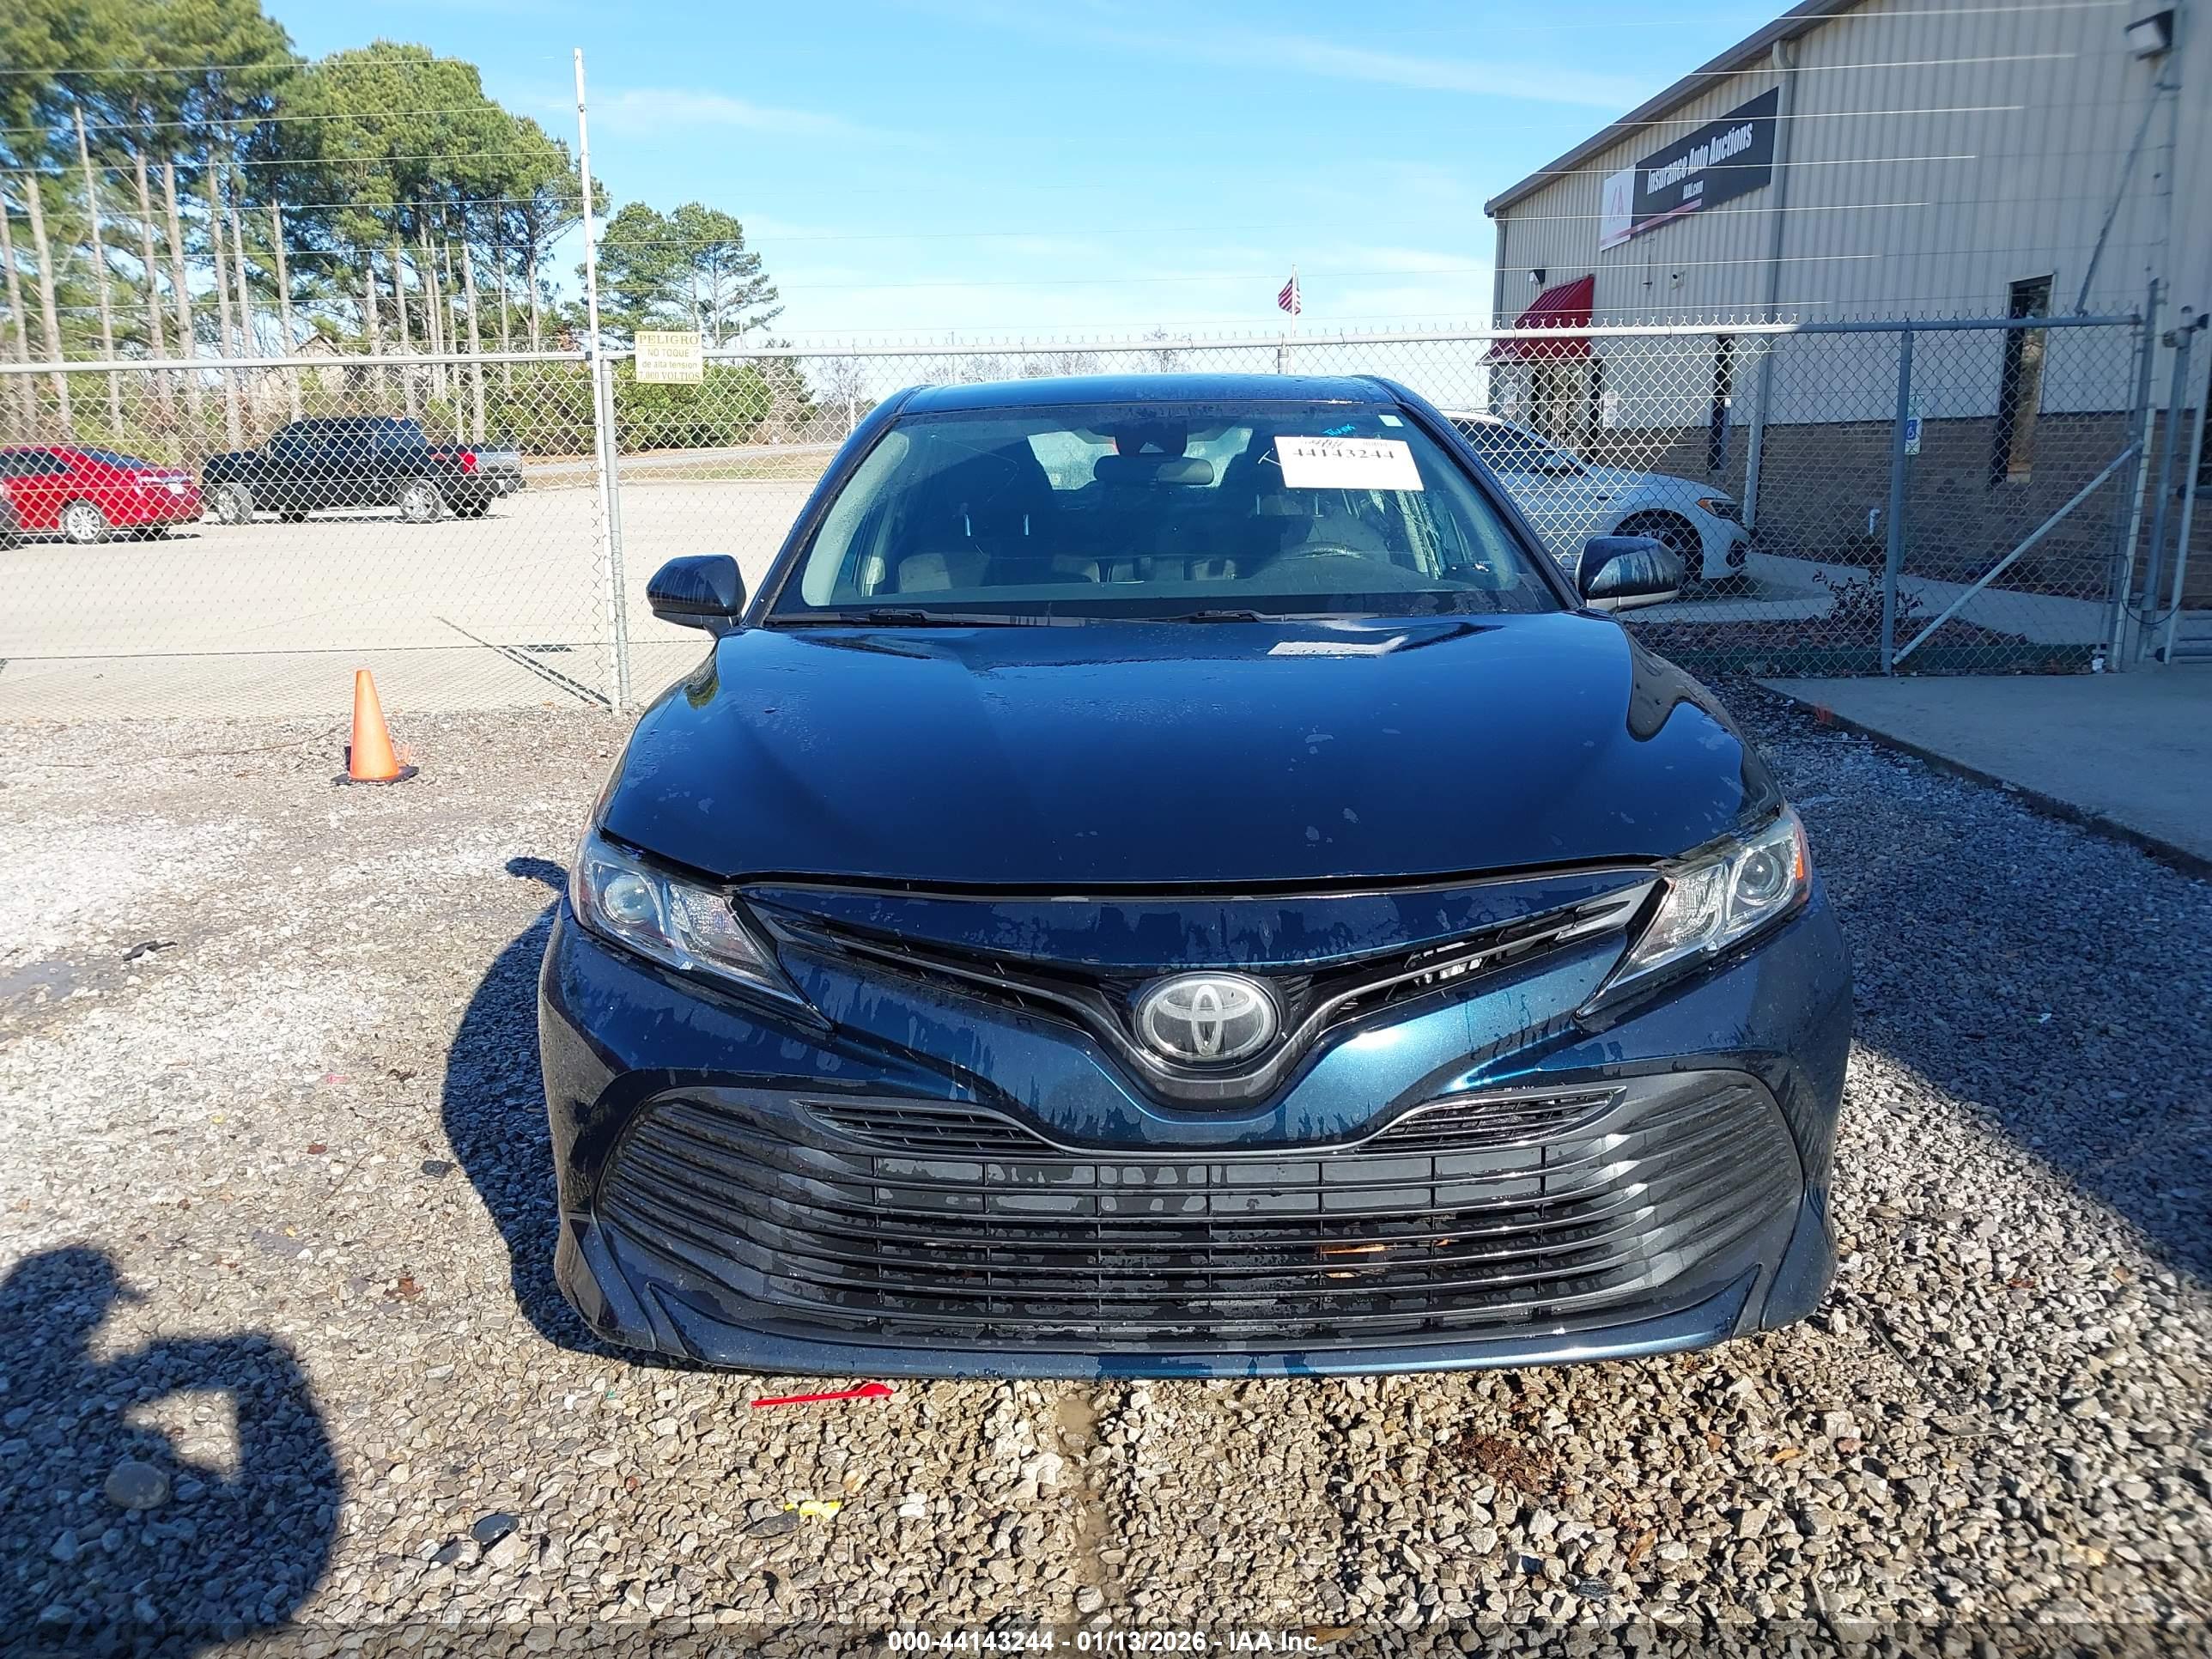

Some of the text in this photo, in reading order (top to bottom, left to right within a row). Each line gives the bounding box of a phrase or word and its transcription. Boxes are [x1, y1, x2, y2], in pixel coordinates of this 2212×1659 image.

[1647, 123, 1753, 195] Insurance Auto Auctions
[639, 335, 698, 345] PELIGRO
[647, 348, 690, 357] NO TOQUE
[662, 372, 700, 380] VOLTIOS
[1292, 447, 1395, 459] 44143244
